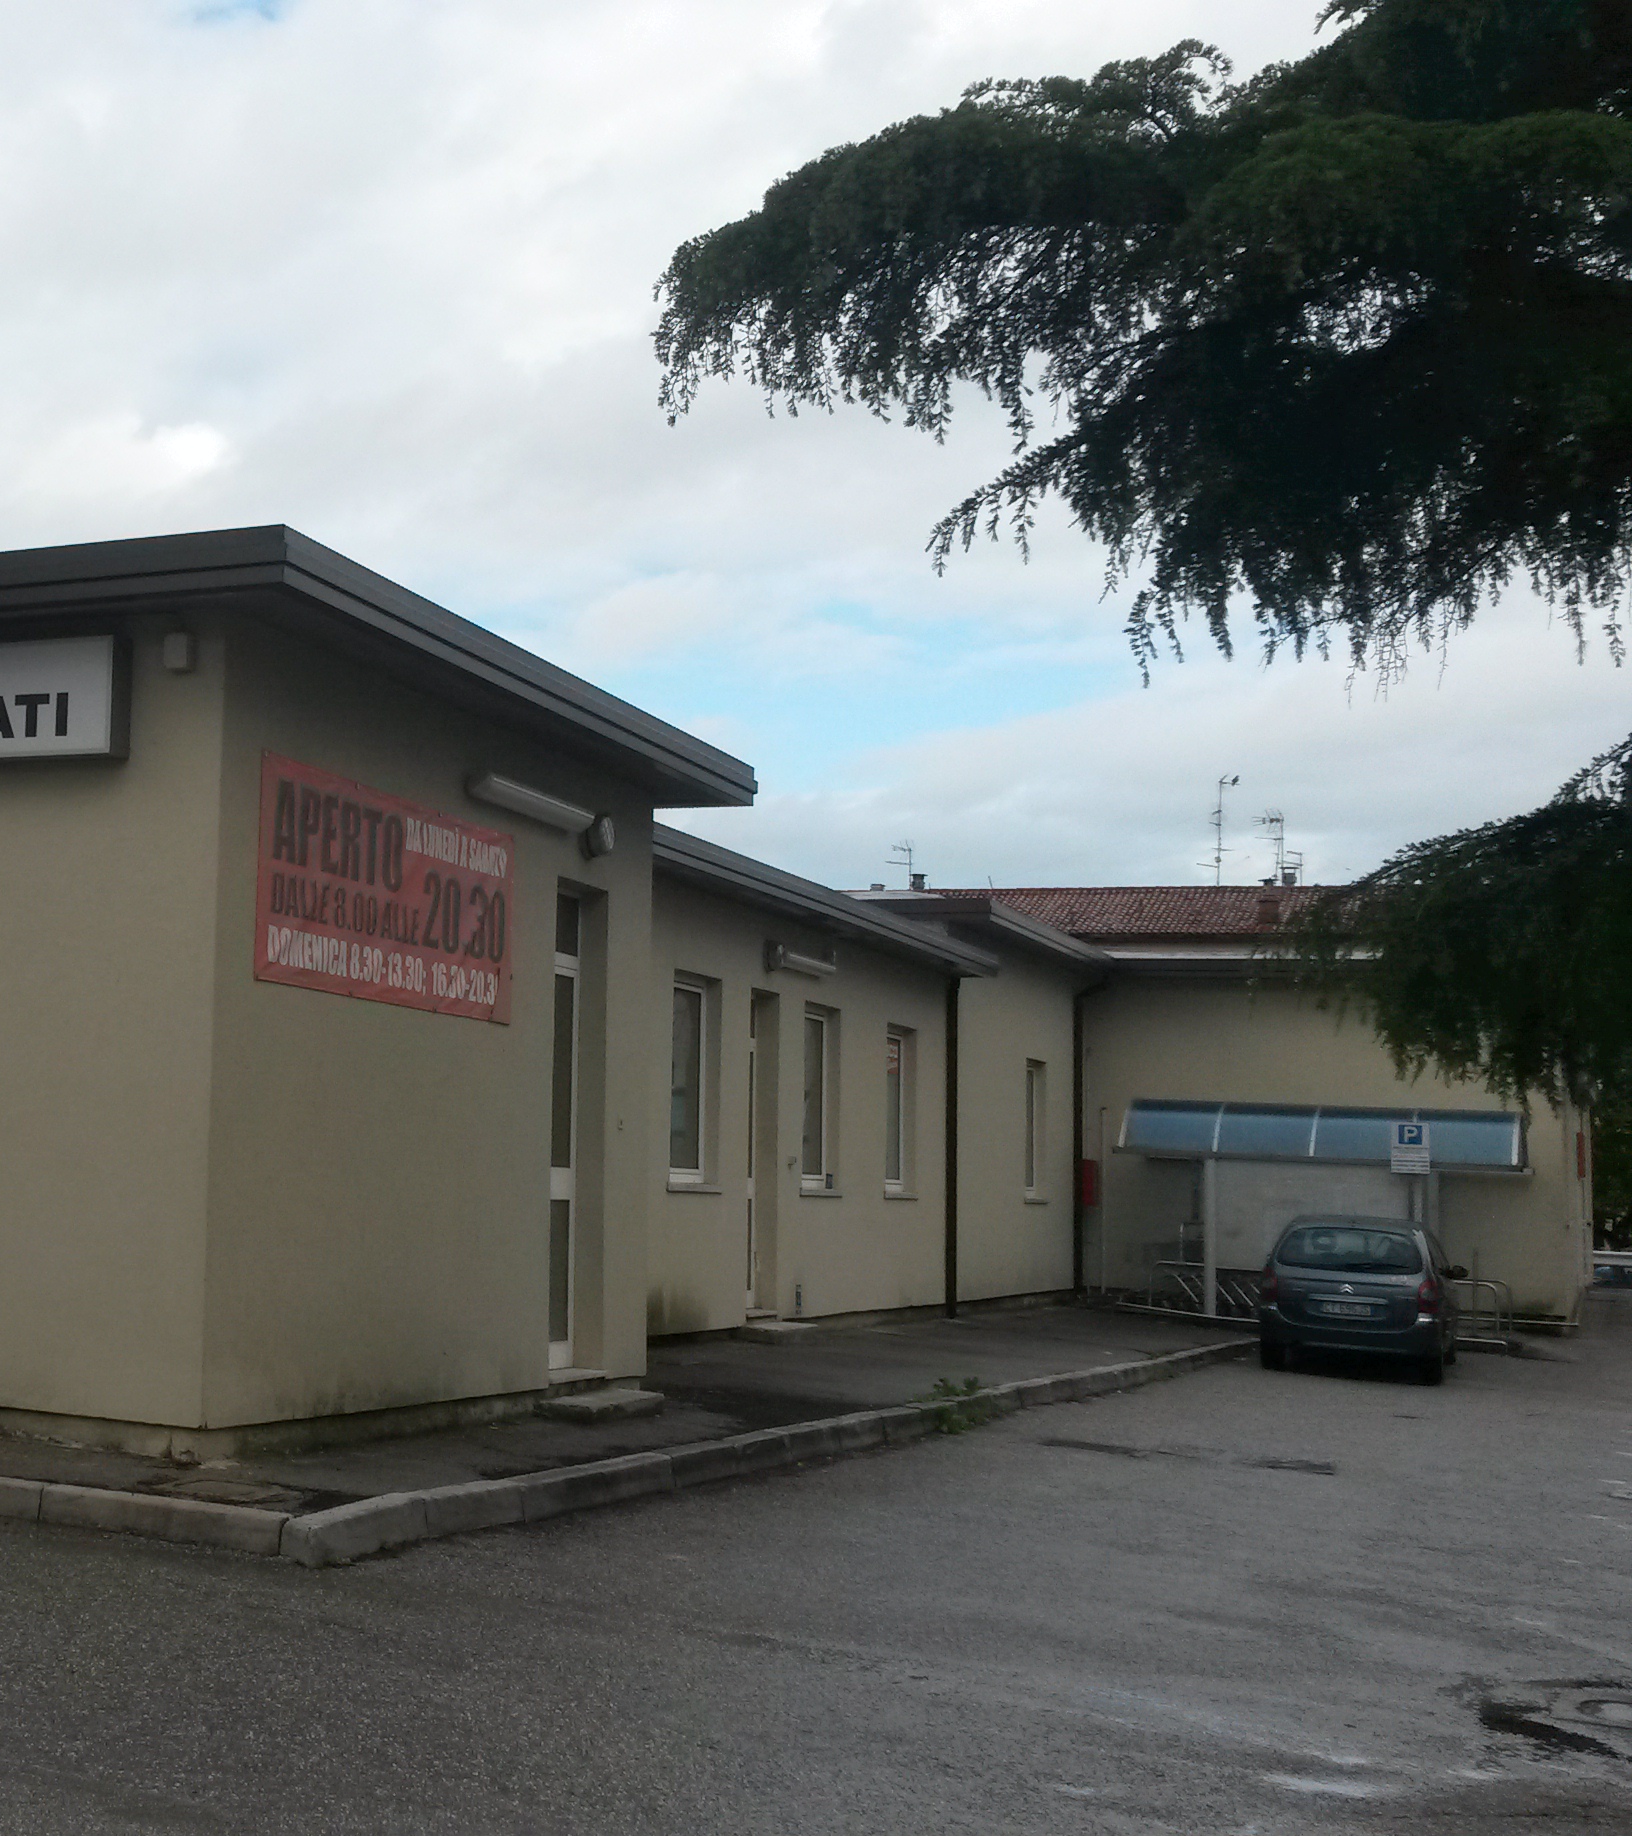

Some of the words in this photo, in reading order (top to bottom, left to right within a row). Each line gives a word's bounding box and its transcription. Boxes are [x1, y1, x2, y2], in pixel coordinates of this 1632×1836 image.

[272, 777, 404, 893] APERTO
[405, 816, 423, 855] DA
[459, 834, 468, 868] A
[270, 871, 330, 926] DALLE
[334, 886, 378, 936] 8.00
[380, 900, 420, 947] ALLE
[421, 867, 506, 964] 20.30
[267, 923, 348, 978] DOMENICA
[1403, 1125, 1419, 1143] P
